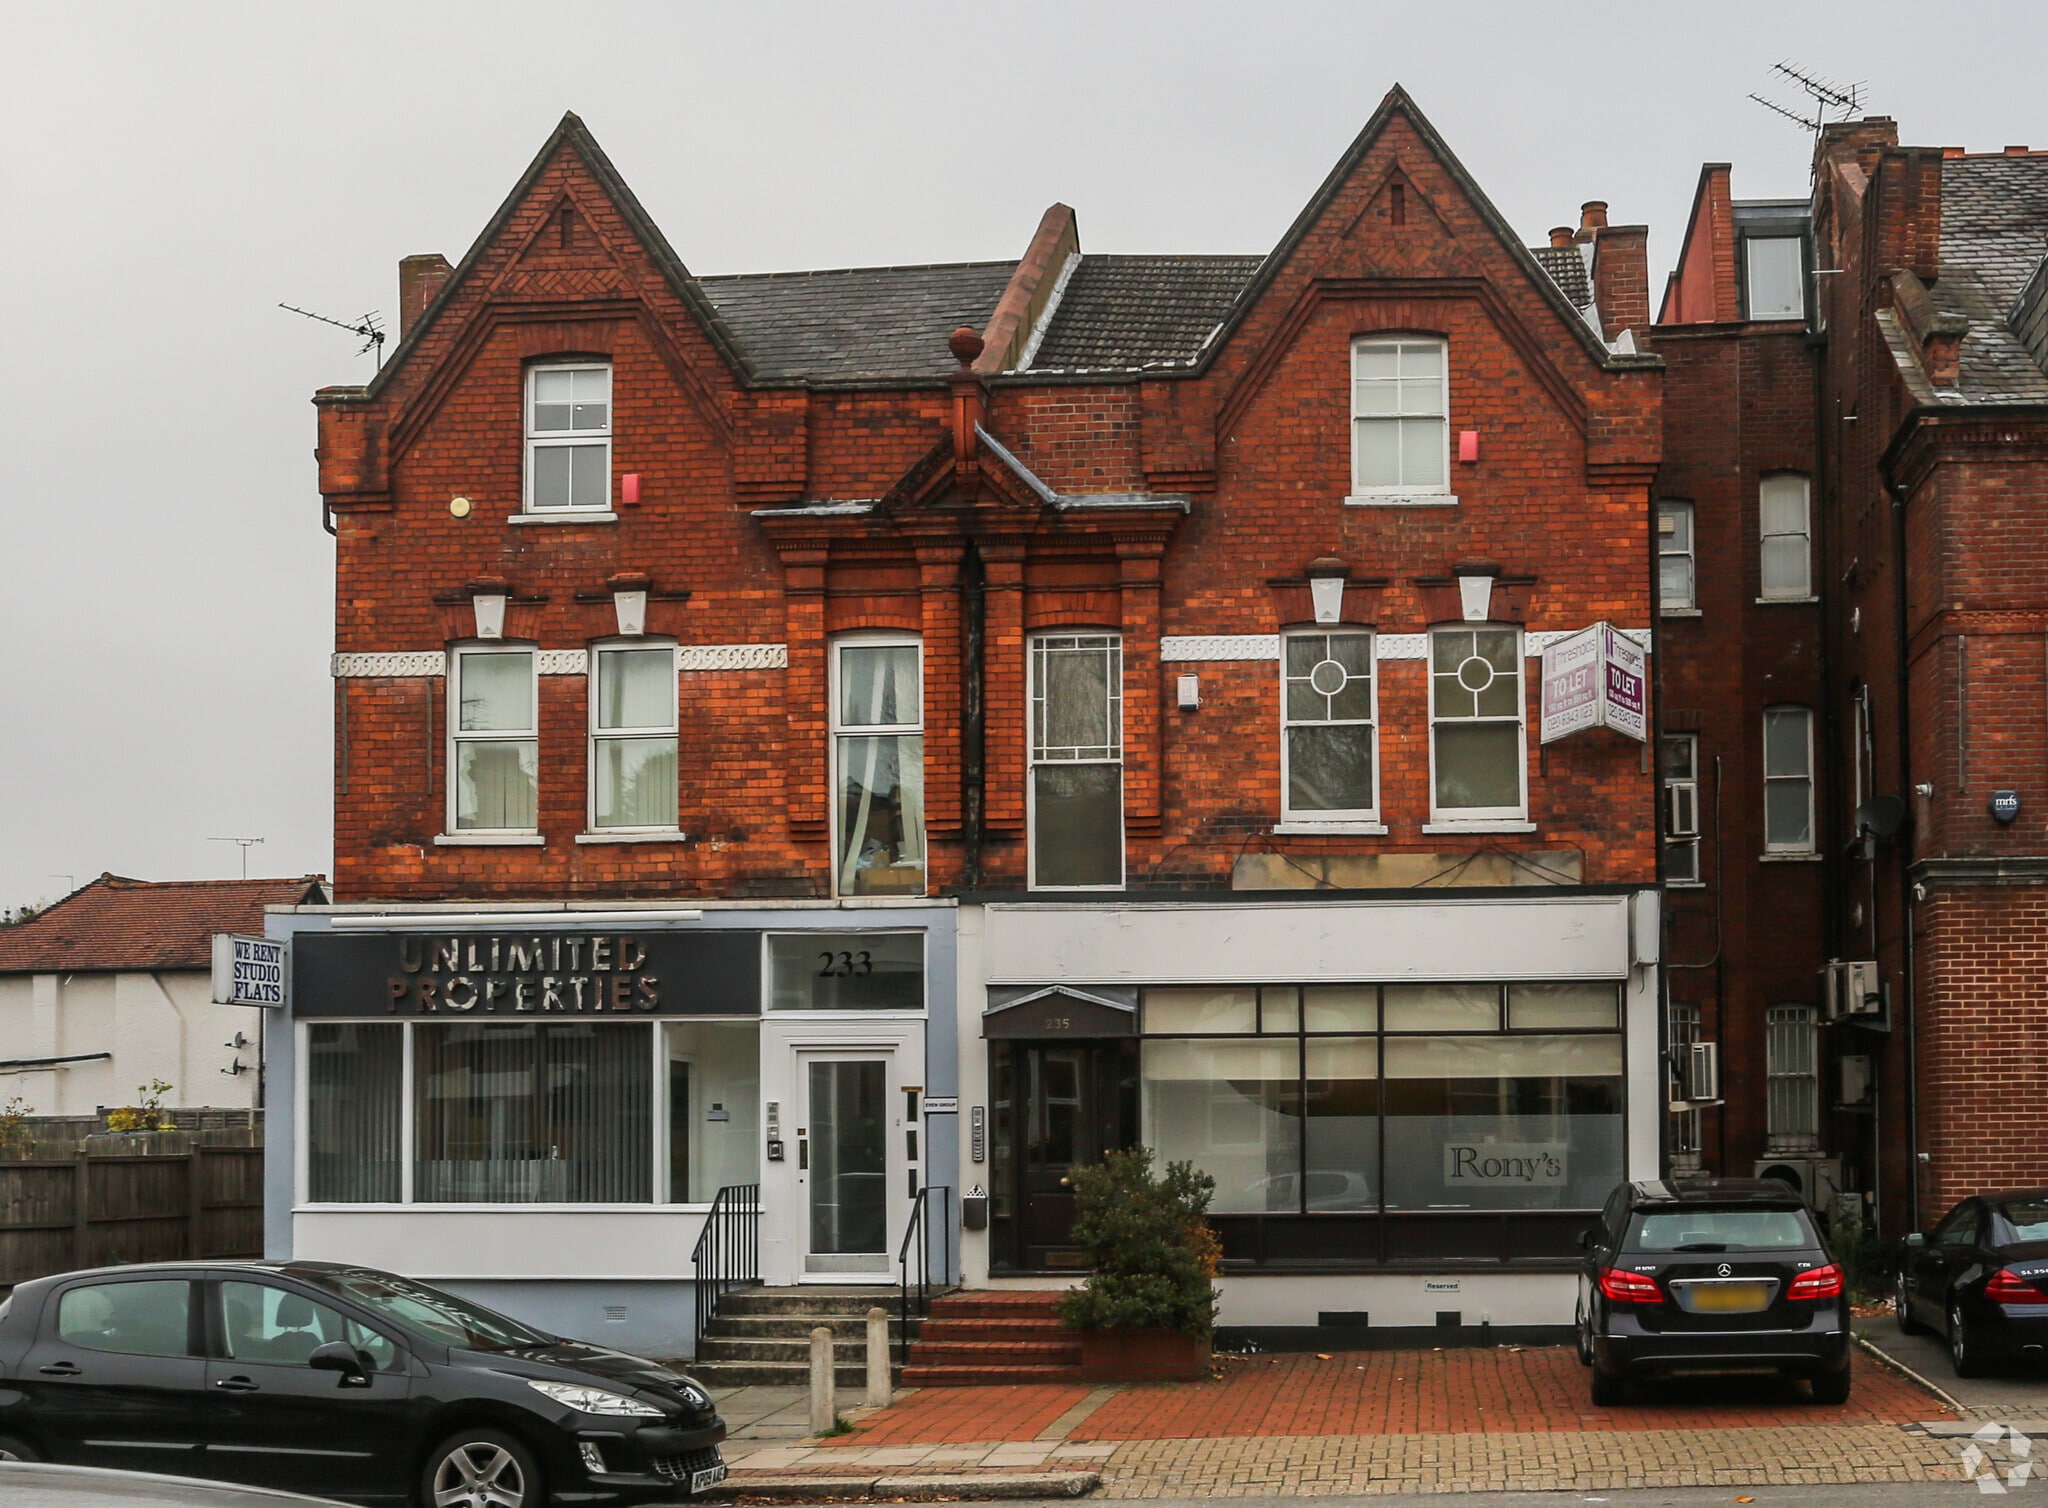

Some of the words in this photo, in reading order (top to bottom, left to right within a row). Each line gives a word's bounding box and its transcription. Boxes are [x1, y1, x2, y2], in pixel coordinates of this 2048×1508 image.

[1552, 678, 1567, 698] TO
[1569, 668, 1588, 693] LET
[1611, 667, 1621, 690] TO
[1622, 673, 1636, 697] LET
[234, 941, 250, 960] WE
[253, 943, 281, 963] RENT
[401, 937, 648, 973] UNLIMITED
[818, 950, 873, 978] 233
[234, 961, 281, 983] STUDIO
[234, 981, 281, 1003] FLATS
[386, 976, 659, 1012] PROPERTIES
[1044, 1018, 1070, 1029] 235
[1450, 1146, 1562, 1182] Rony's
[1426, 1282, 1459, 1290] Reserved
